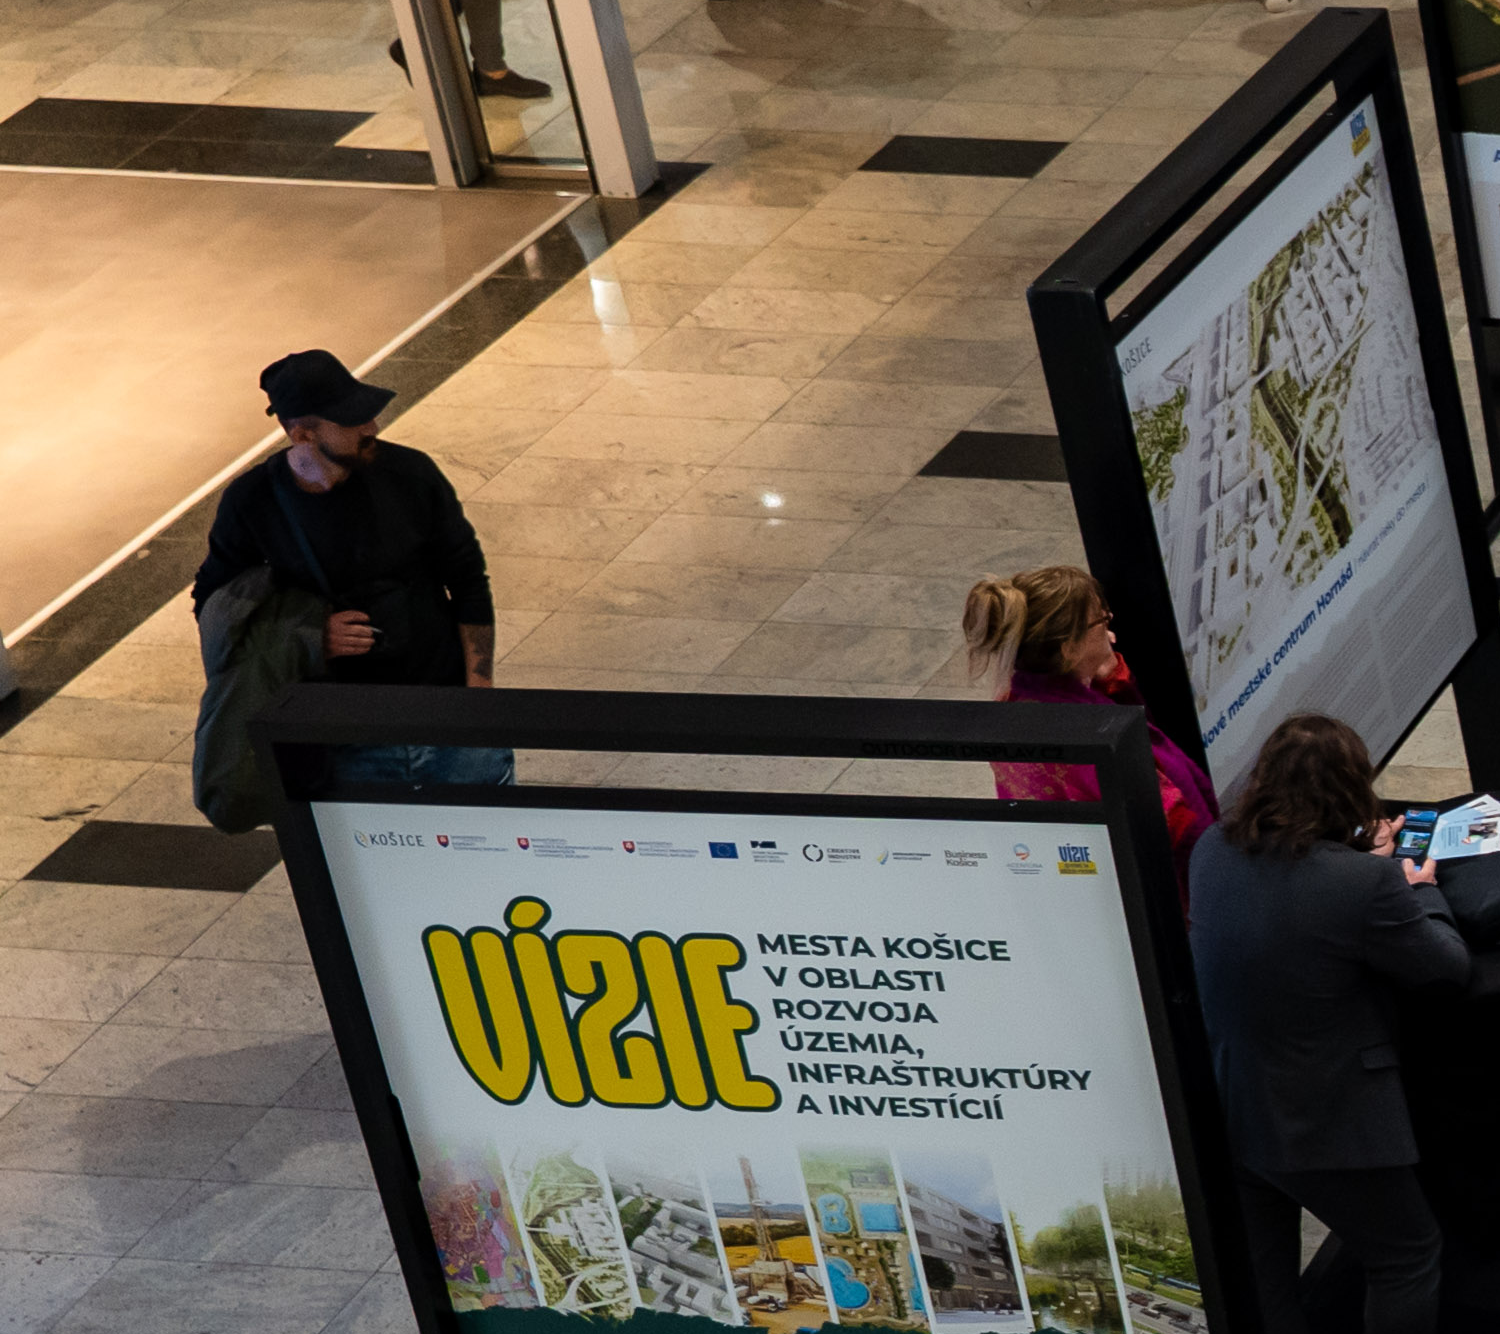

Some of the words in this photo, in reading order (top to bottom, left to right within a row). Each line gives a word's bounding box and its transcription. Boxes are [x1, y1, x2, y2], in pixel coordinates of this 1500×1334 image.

[1227, 657, 1272, 720] mestské
[1273, 609, 1317, 665] centrum
[1316, 562, 1354, 615] Hornád
[370, 832, 425, 848] KOŠICE
[1058, 843, 1090, 863] VÍZIE
[757, 933, 873, 958] MESTA
[884, 932, 1011, 962] KOŠICE
[763, 966, 787, 987] V
[797, 966, 946, 993] OBLASTI
[421, 895, 782, 1112] VÍZIE
[773, 998, 939, 1025] ROZVOJA
[780, 1030, 925, 1060] ÚZEMIA,
[788, 1060, 1092, 1092] INFRAŠTRUKTÚRY
[796, 1093, 822, 1115] A
[830, 1093, 1004, 1120] INVESTÍCIÍ
